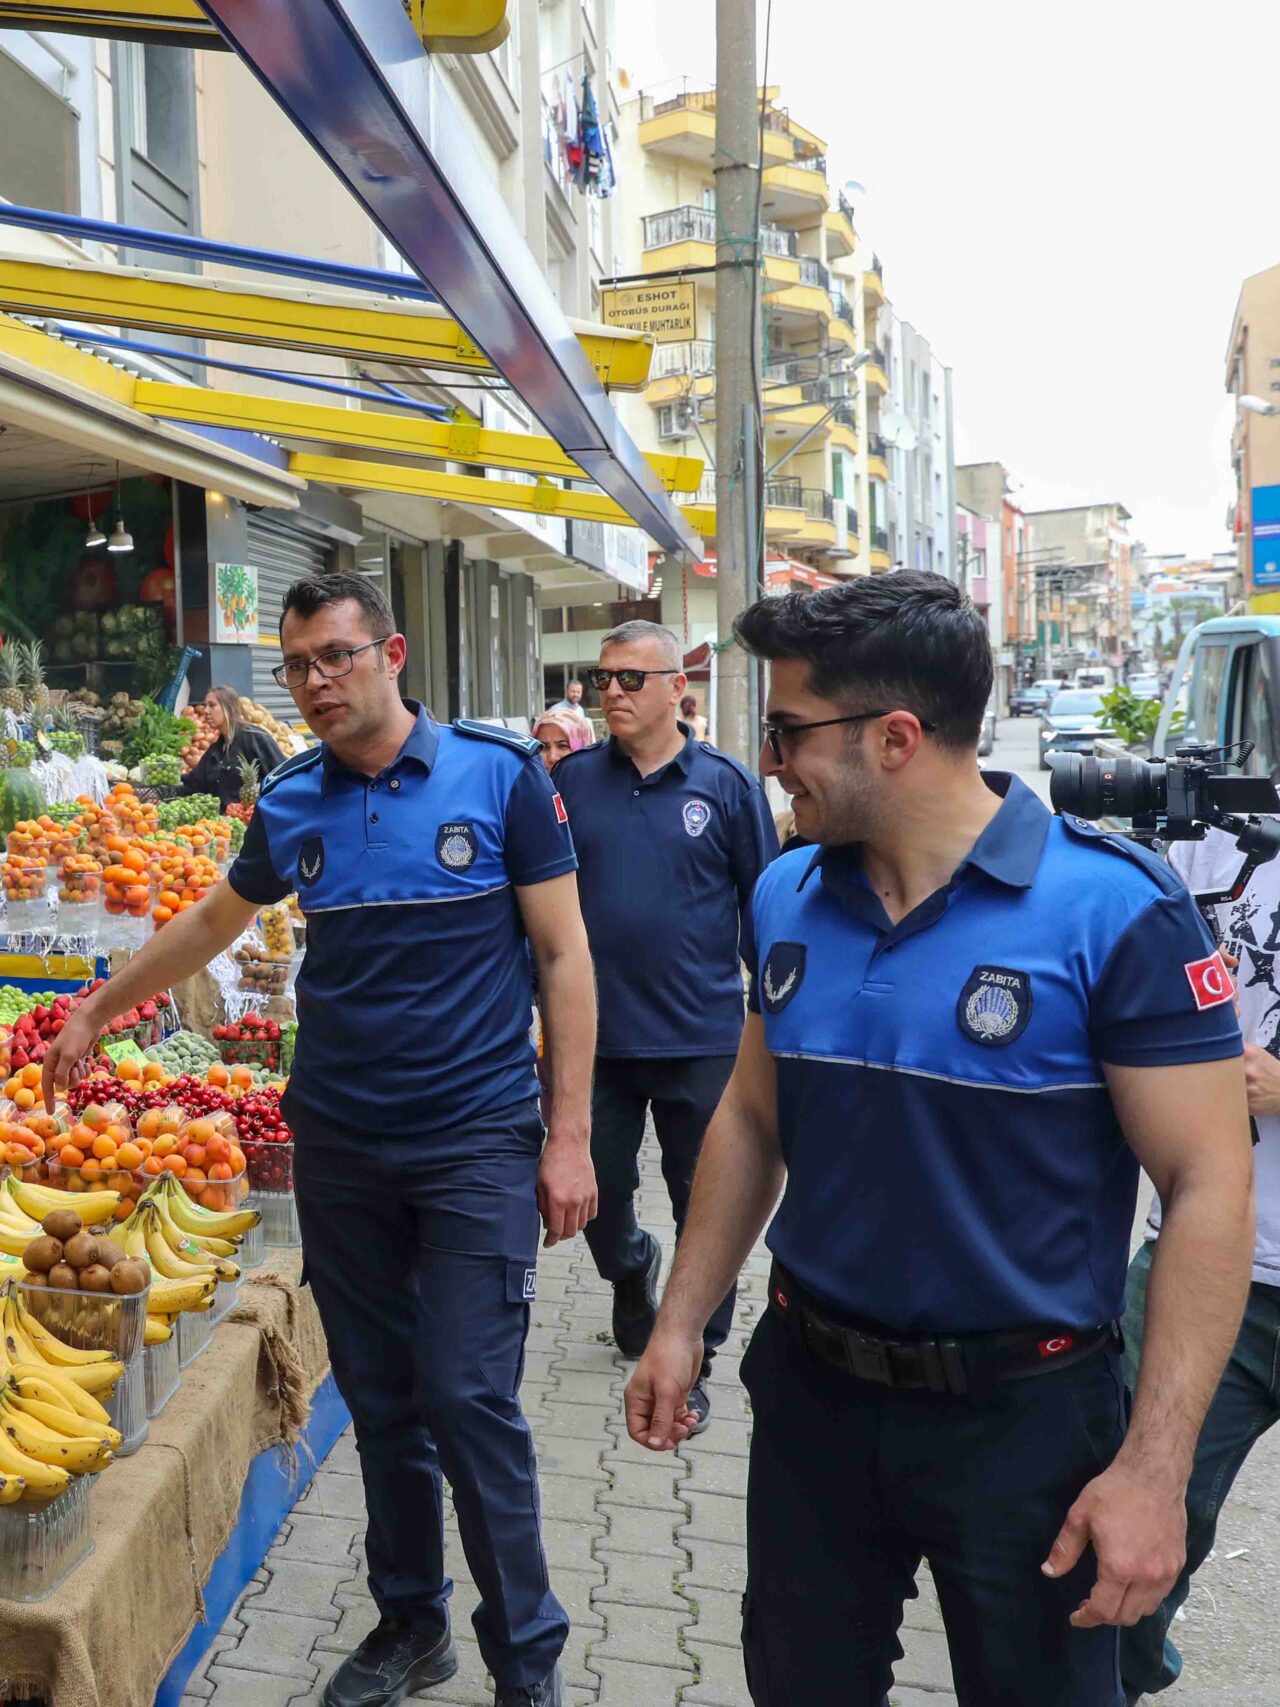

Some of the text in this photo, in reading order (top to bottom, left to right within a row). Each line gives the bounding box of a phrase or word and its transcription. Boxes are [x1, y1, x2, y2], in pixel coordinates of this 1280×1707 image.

[637, 291, 678, 303] ESHOT
[608, 302, 690, 318] OTOBÜS DURAĞI
[649, 317, 692, 332] MUHTARLIK
[443, 826, 470, 834] ZABITA
[979, 971, 1021, 989] ZABITA
